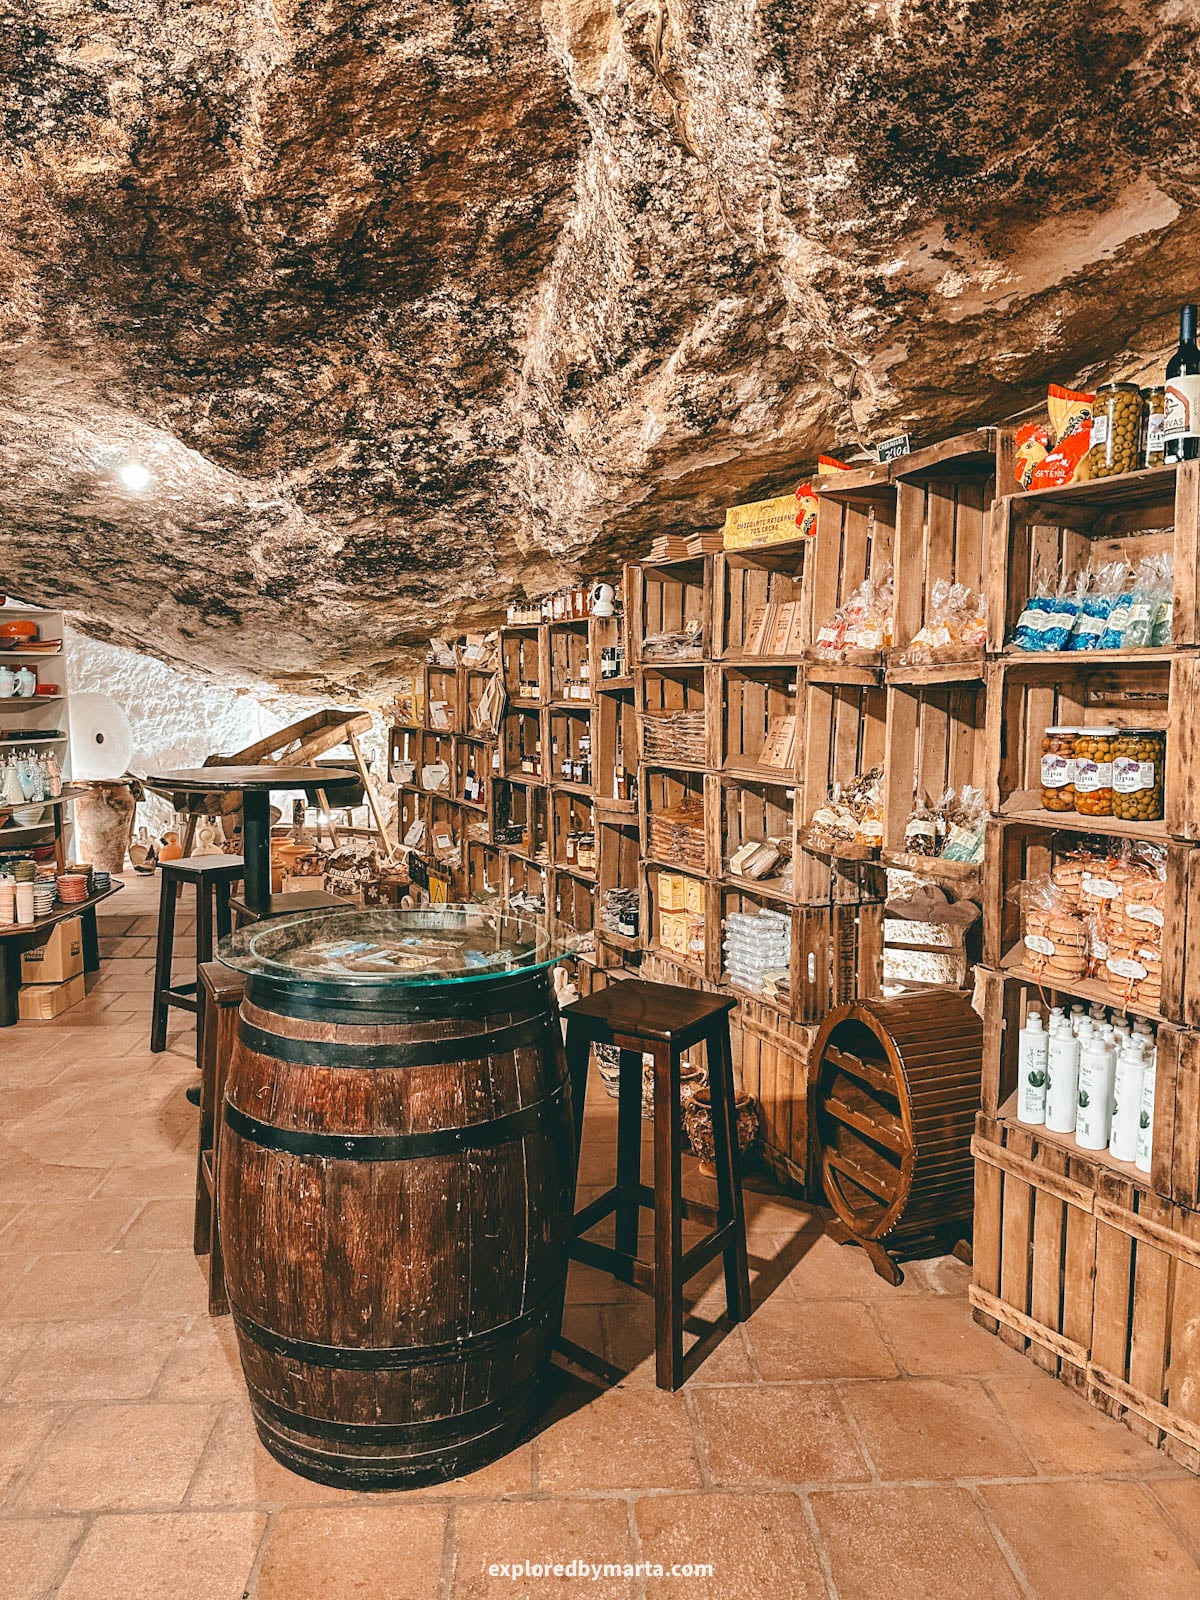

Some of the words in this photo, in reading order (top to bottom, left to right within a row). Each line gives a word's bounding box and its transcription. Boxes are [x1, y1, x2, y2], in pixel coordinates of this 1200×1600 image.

[1165, 418, 1184, 429] EVAS
[737, 519, 766, 530] CHOCOLATE
[761, 525, 779, 533] CACAO
[892, 853, 918, 868] 2'10
[840, 918, 854, 961] ALONSO
